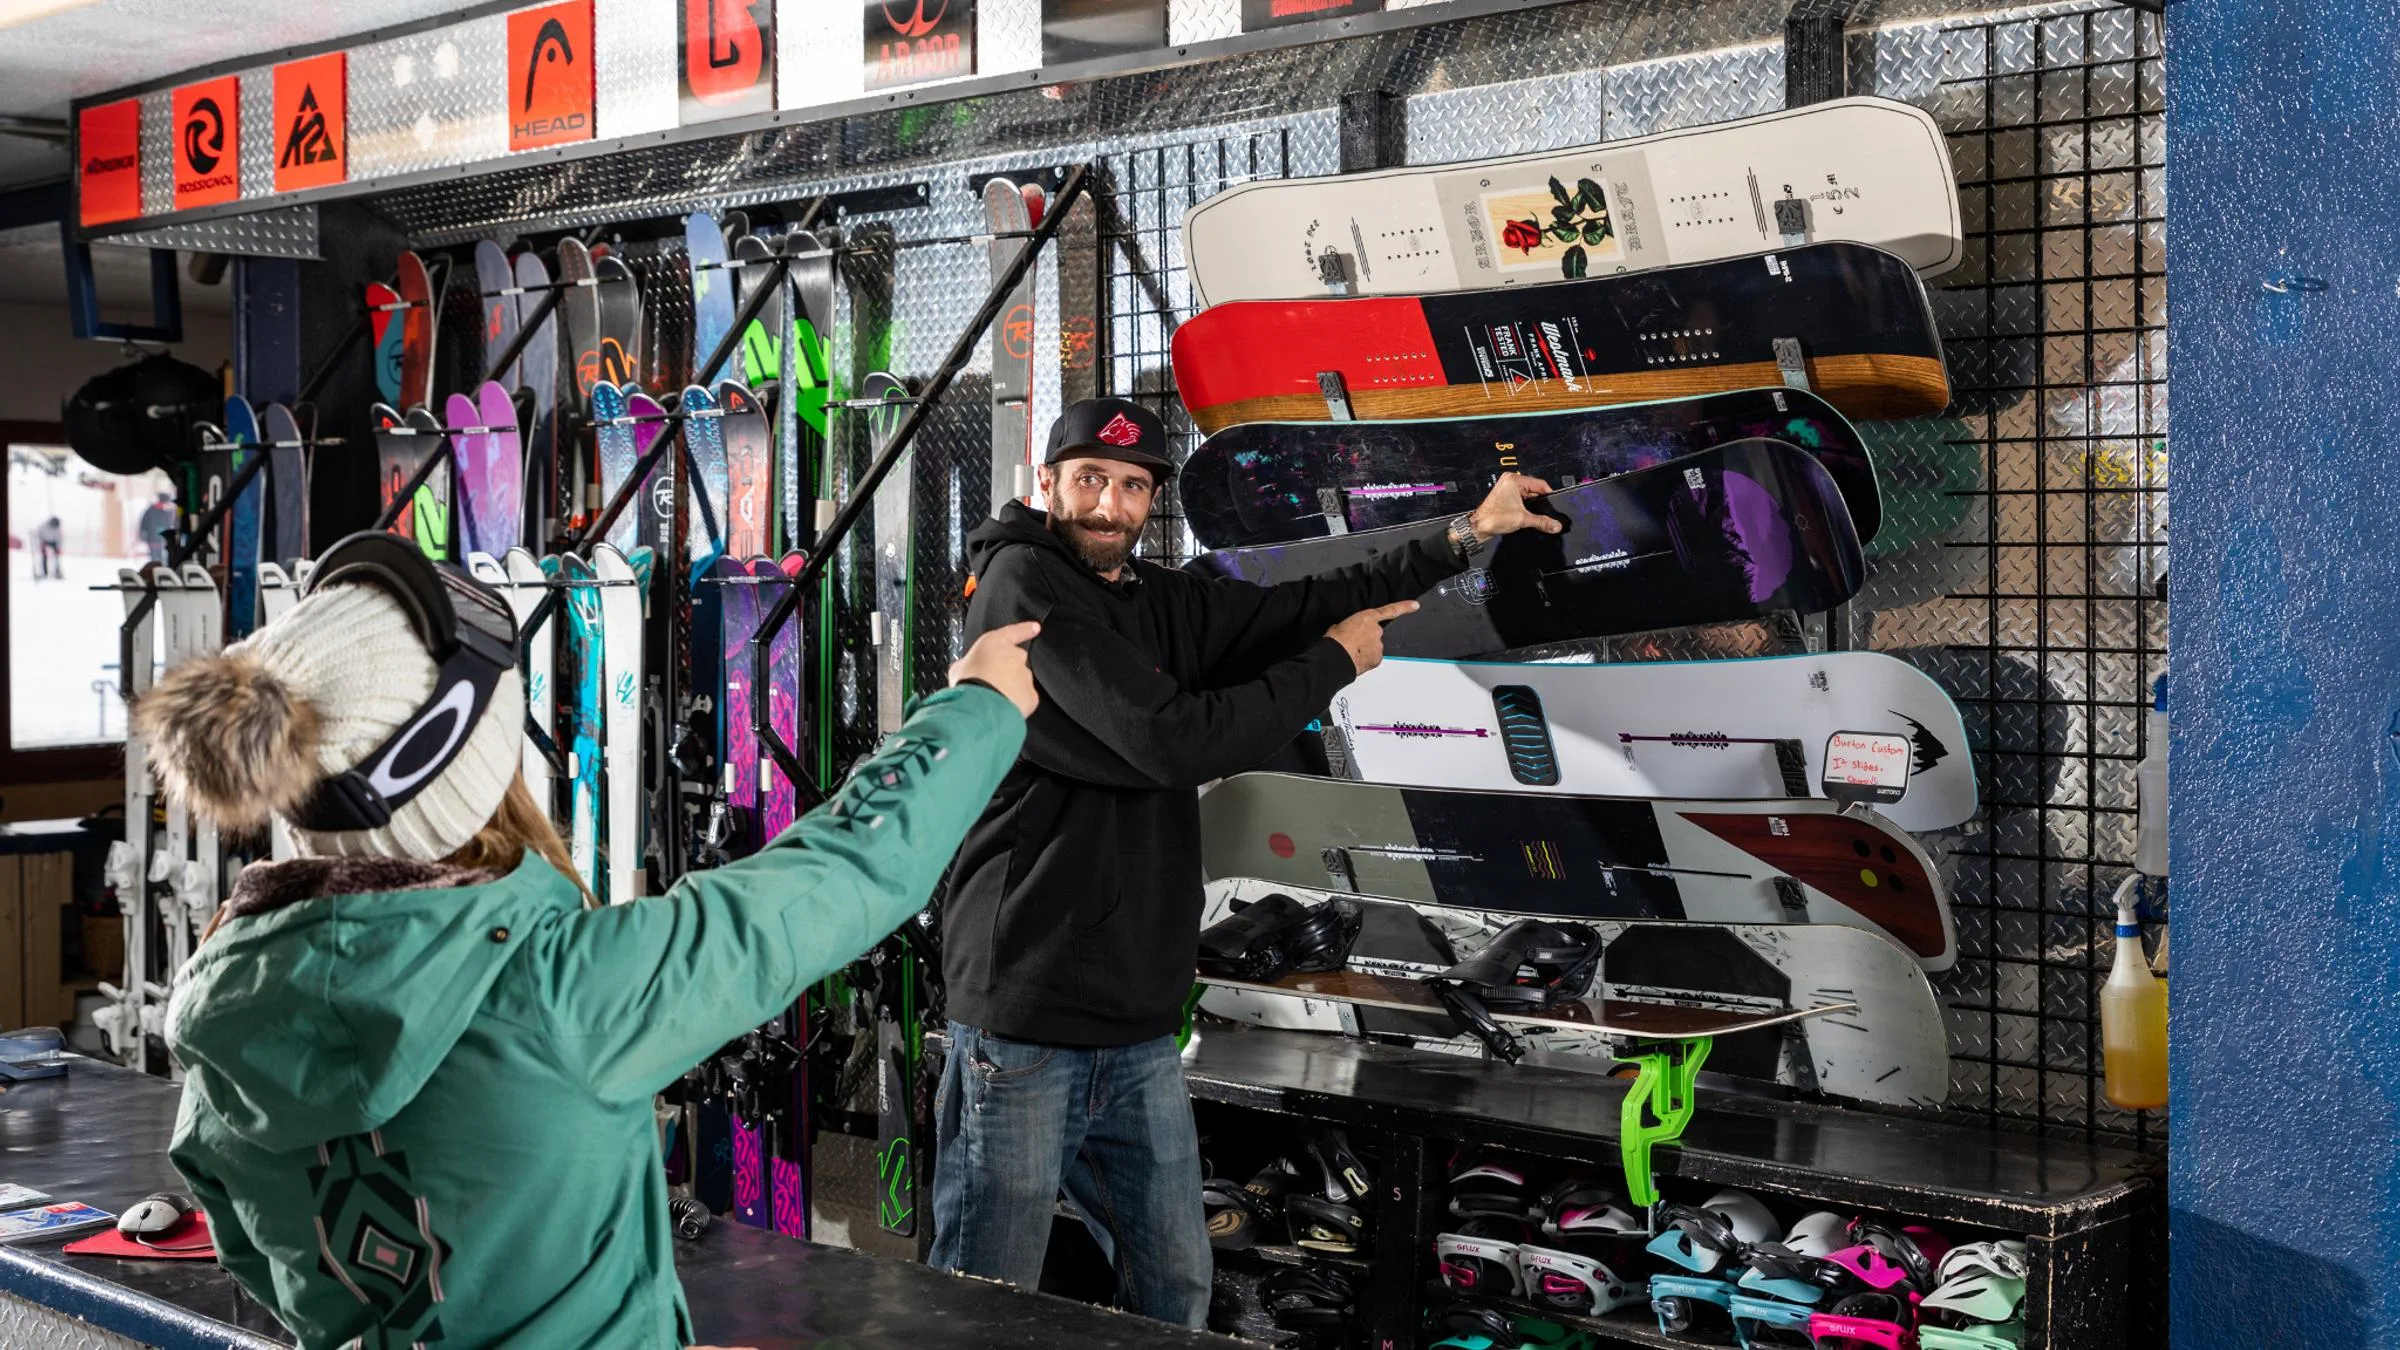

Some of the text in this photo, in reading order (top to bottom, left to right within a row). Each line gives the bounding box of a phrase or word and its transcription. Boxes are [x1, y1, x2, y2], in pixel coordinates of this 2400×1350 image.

[513, 113, 585, 138] HEAD
[177, 175, 234, 195] ROSSIGNOL
[1494, 326, 1509, 357] TESTED
[1501, 325, 1518, 356] FRANK
[1528, 333, 1541, 359] FRANK
[1833, 736, 1904, 755] Burton Custom
[1393, 1187, 1402, 1201] S
[1460, 1244, 1480, 1254] FLUX
[1535, 1255, 1552, 1265] FLUX
[1676, 1285, 1697, 1295] FLUX
[1834, 1324, 1856, 1335] FLUX
[1382, 1339, 1393, 1350] M
